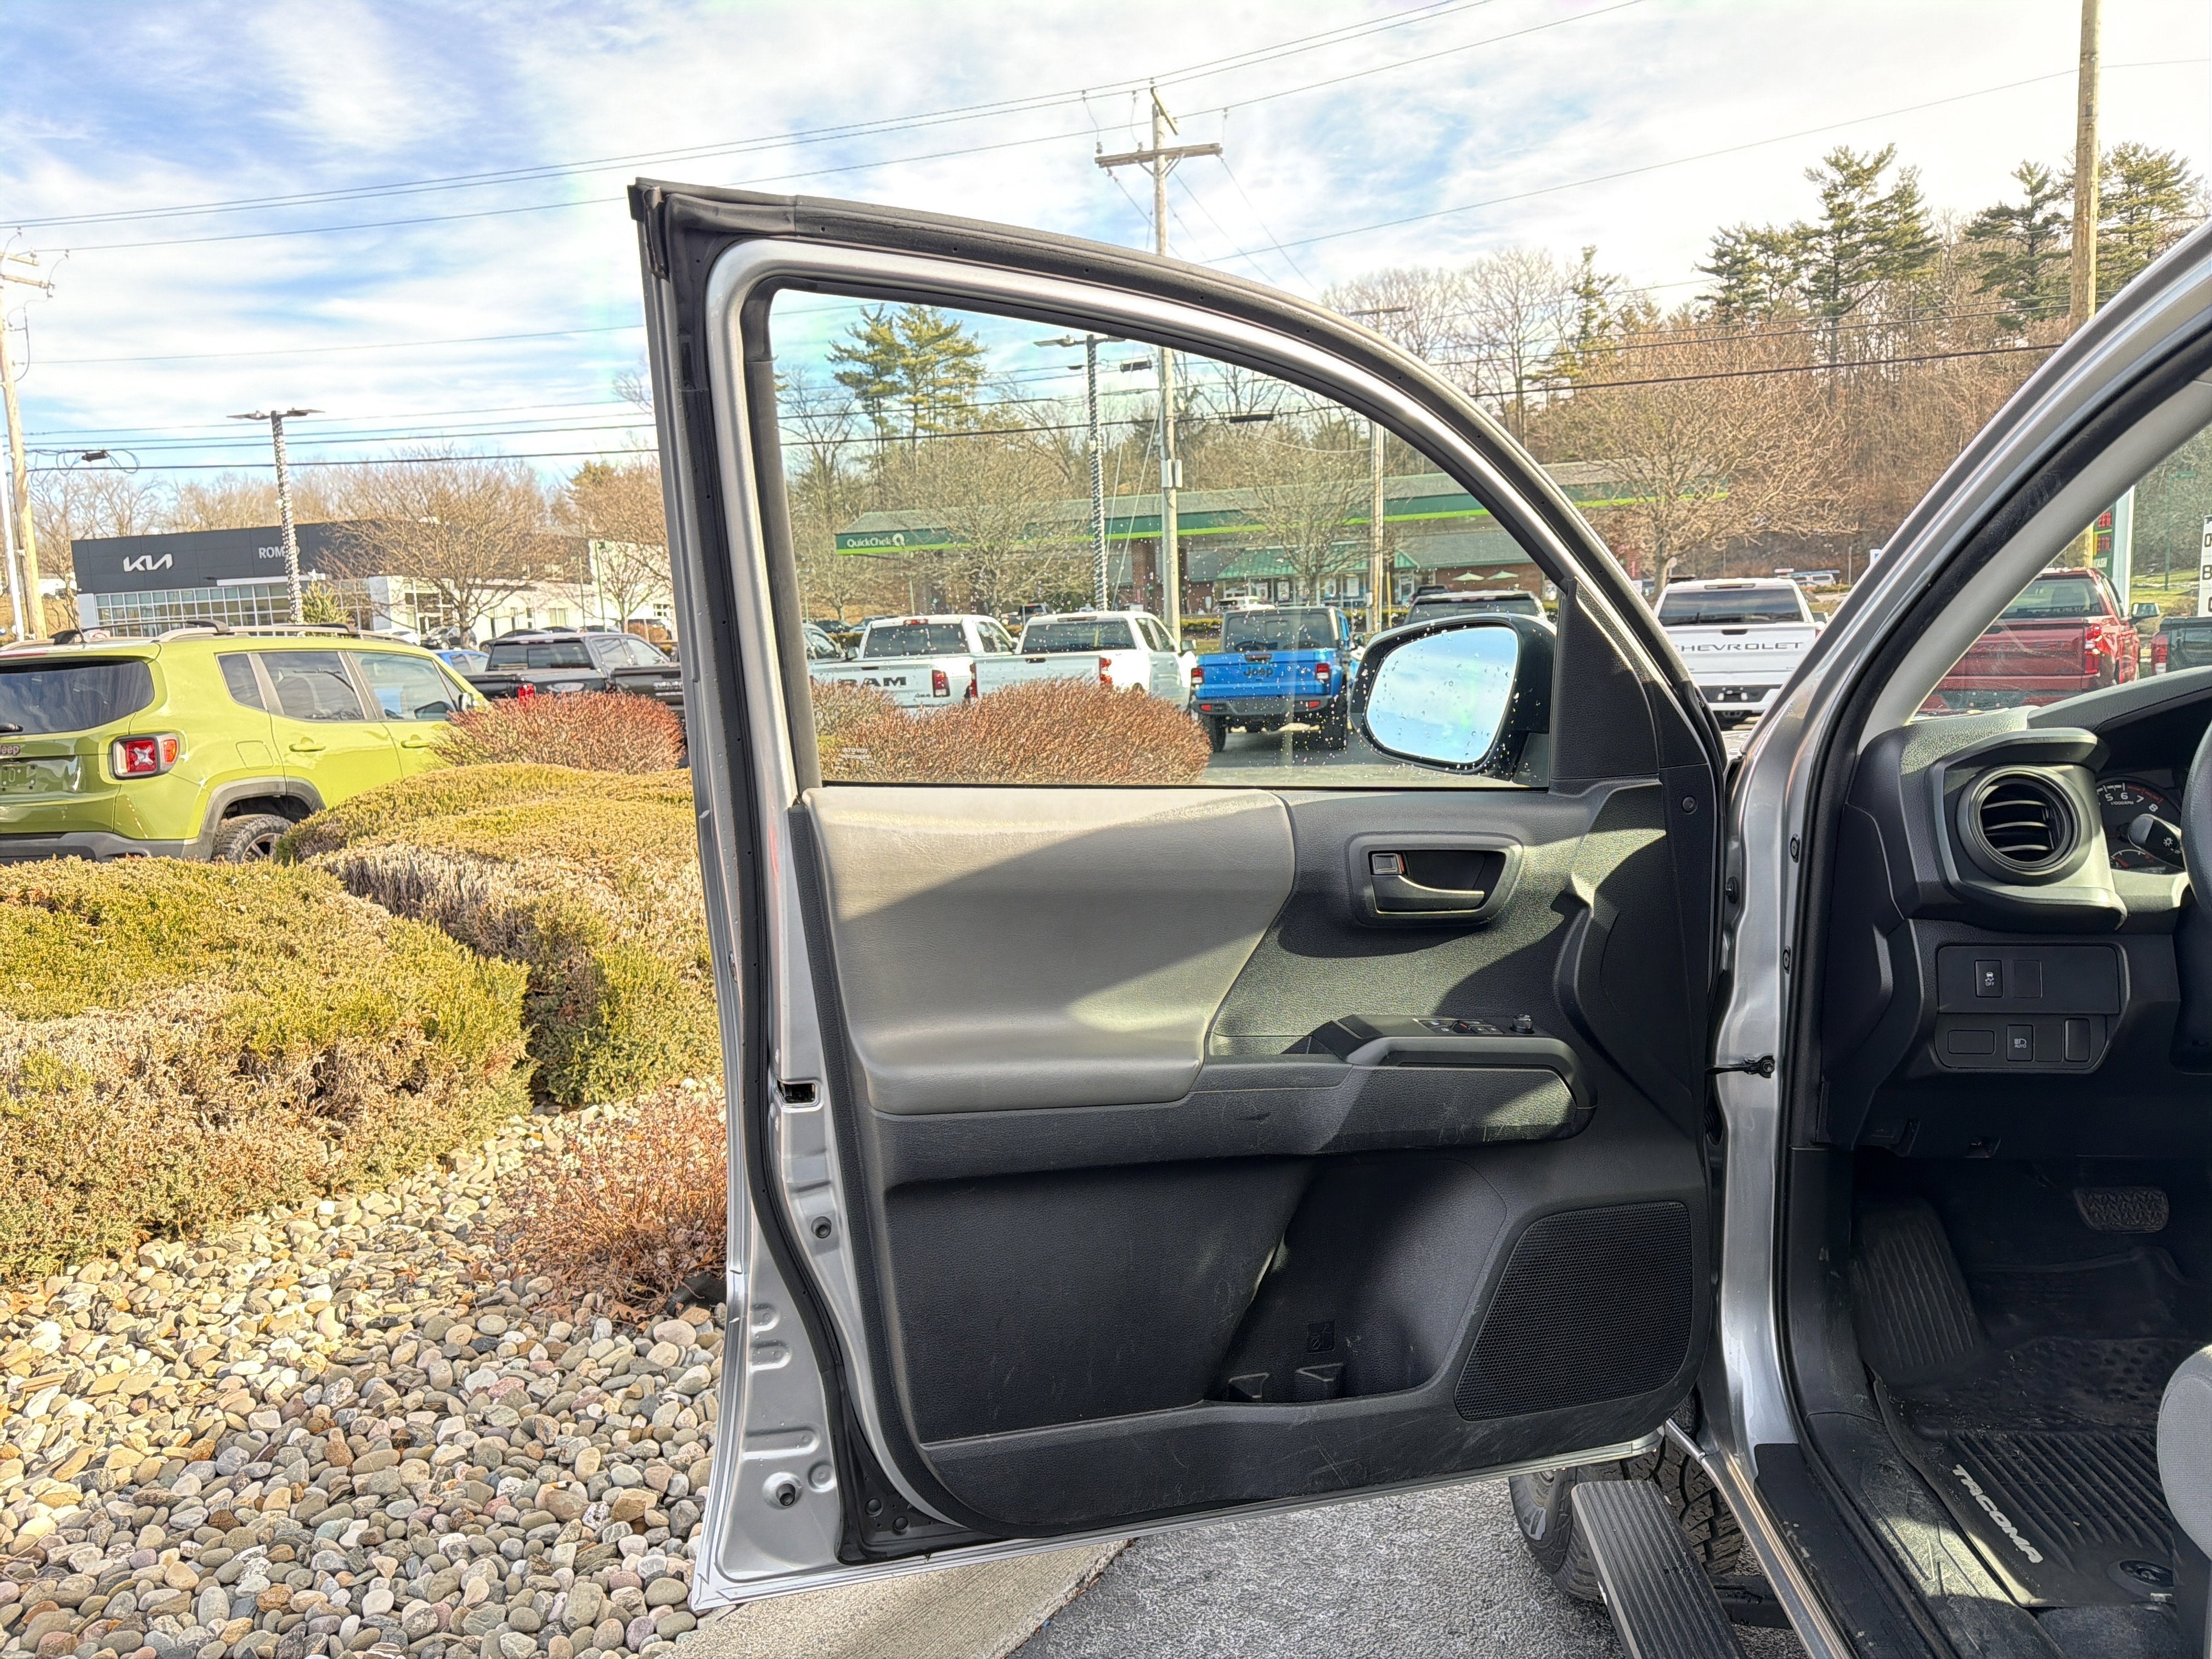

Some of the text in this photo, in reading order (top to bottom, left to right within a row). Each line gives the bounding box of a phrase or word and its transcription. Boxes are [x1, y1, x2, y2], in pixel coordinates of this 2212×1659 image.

[258, 546, 300, 559] ROM
[123, 554, 173, 572] KIA
[1675, 641, 1803, 652] HEVROLET
[0, 743, 20, 756] eep
[1953, 1464, 2044, 1564] TACOMA
